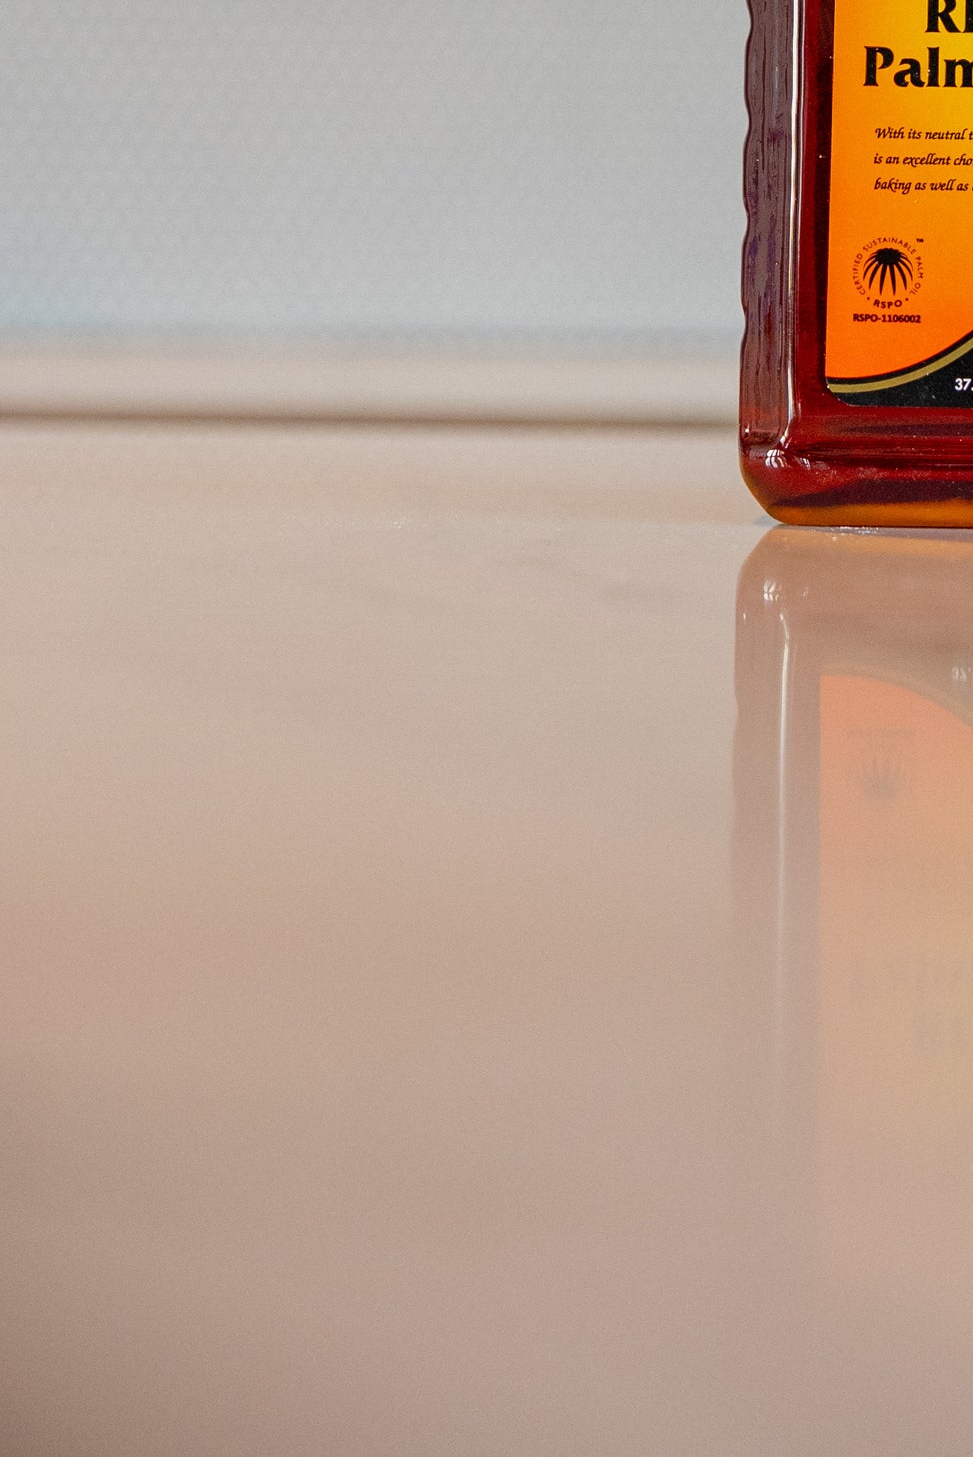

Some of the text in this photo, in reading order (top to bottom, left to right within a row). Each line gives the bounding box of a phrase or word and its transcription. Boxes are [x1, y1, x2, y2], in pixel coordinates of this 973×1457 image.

[875, 126, 905, 139] With
[908, 128, 922, 140] its
[925, 128, 968, 140] neutral
[873, 153, 883, 164] is
[885, 156, 900, 165] an
[902, 152, 951, 168] excellent
[874, 177, 912, 195] baking
[914, 182, 927, 191] as
[929, 178, 957, 191] well
[956, 182, 969, 191] as
[853, 253, 866, 295] CERTIFIED
[862, 236, 917, 255] SUSTAINABLE
[909, 282, 921, 295] OIL
[873, 299, 903, 309] RSPO
[852, 313, 921, 323] RSPO-1106002
